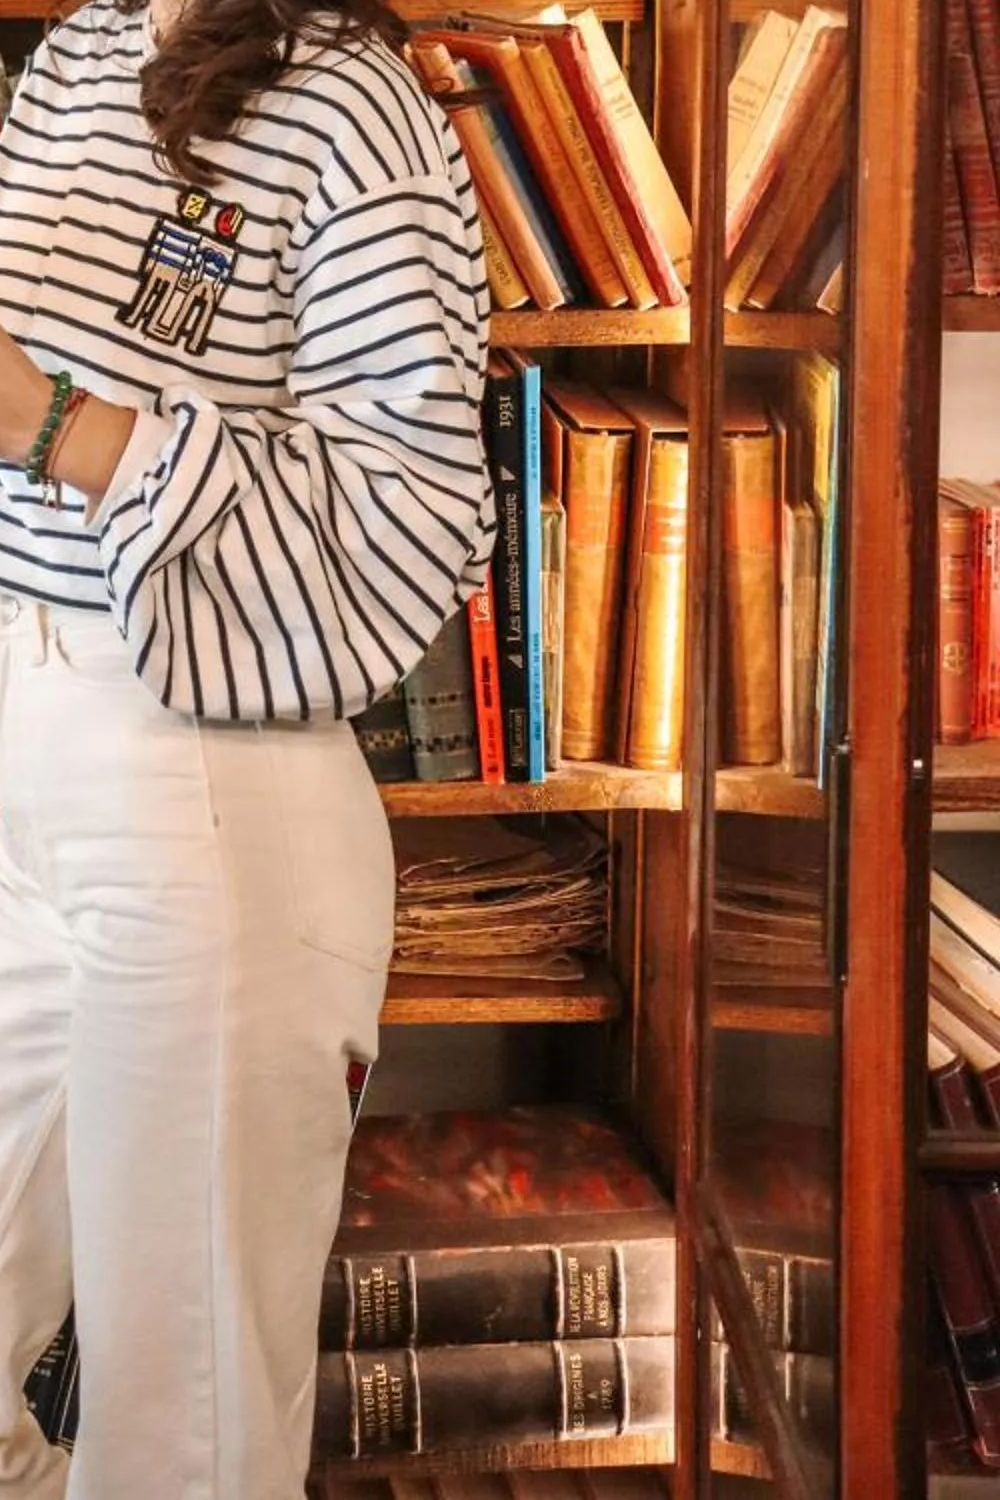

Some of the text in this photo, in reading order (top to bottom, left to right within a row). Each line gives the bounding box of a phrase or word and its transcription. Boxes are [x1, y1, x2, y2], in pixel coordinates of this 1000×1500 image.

[499, 395, 514, 428] 1931
[502, 492, 520, 642] Les années-mémoire
[569, 1352, 585, 1411] ORIGINES
